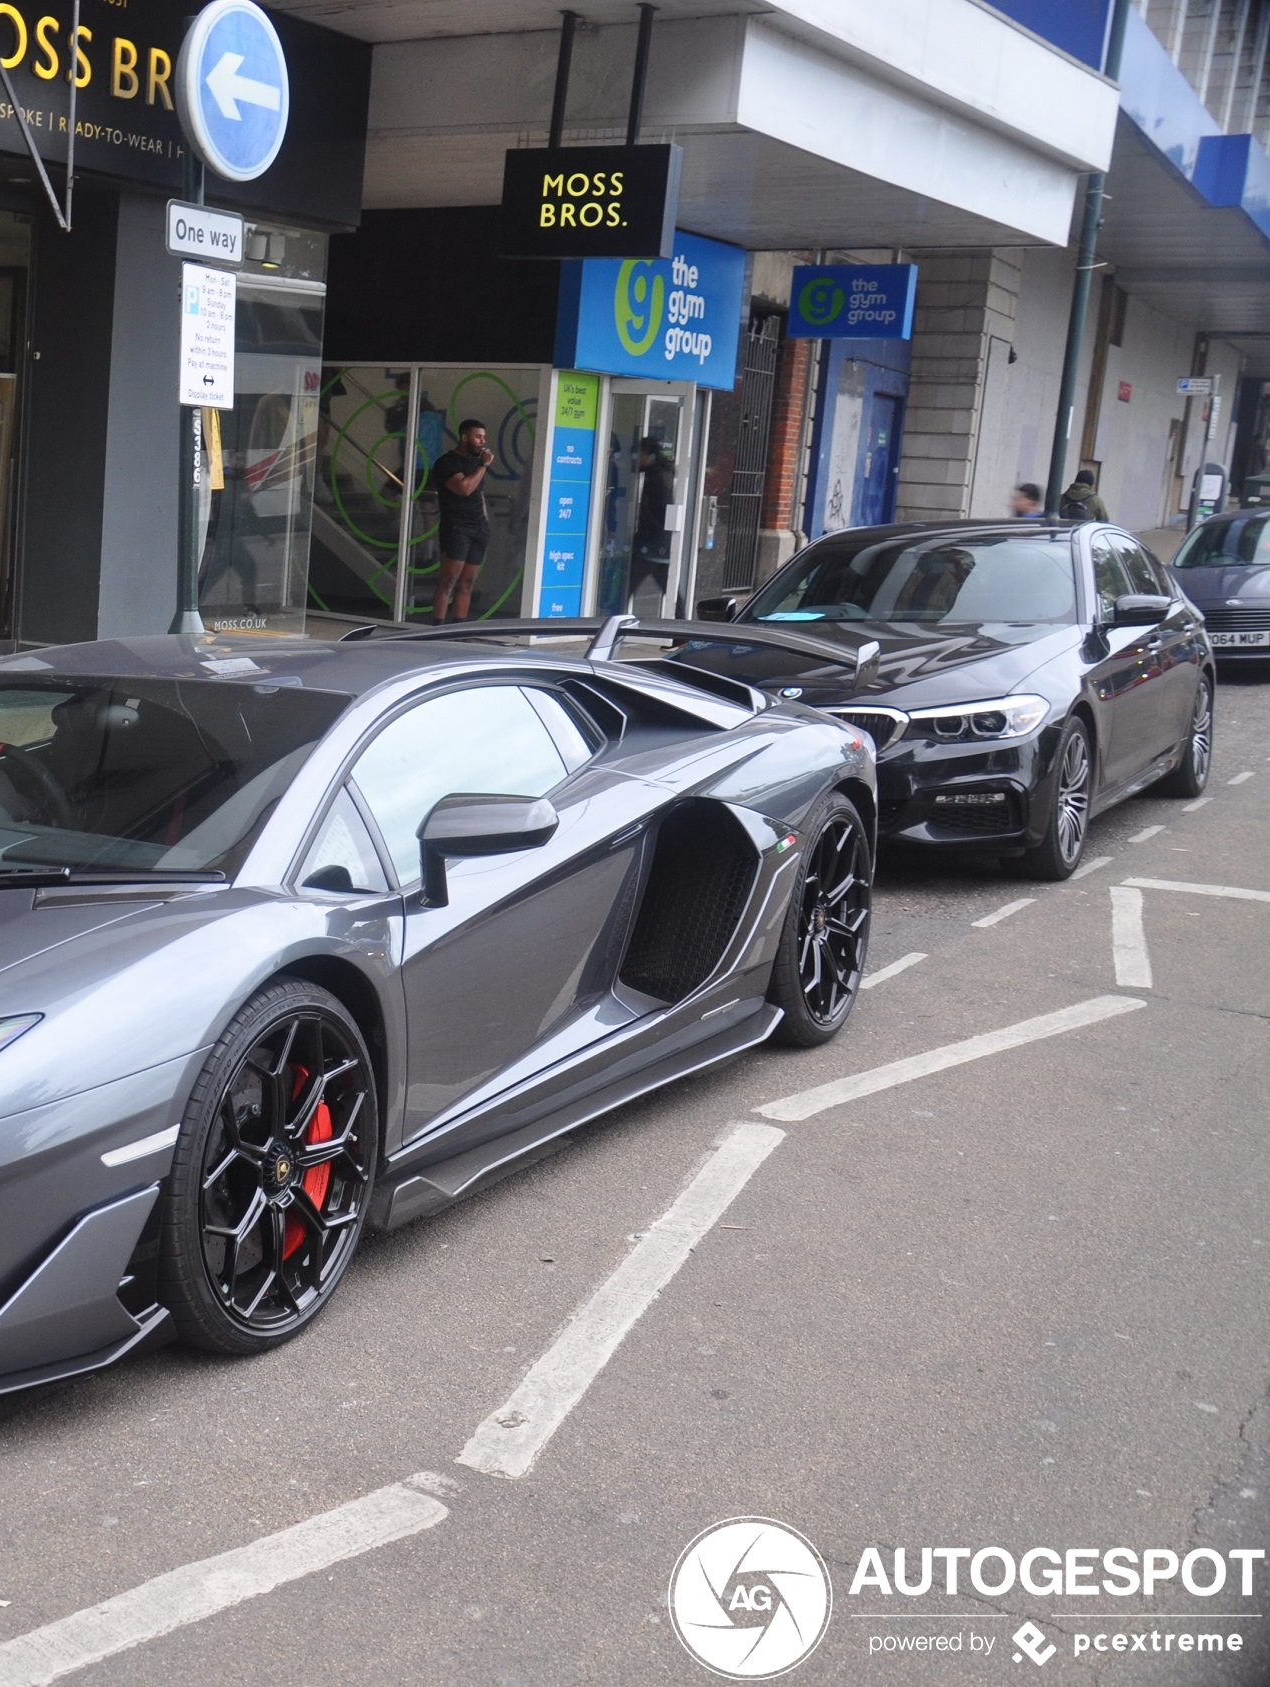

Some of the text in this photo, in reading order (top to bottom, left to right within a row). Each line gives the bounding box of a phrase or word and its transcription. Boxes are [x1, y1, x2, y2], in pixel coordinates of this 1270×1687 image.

[110, 36, 174, 111] BR
[542, 172, 624, 197] MOSS
[539, 202, 628, 228] BROS.
[175, 218, 237, 254] One way
[671, 254, 699, 289] the
[205, 273, 231, 287] Mon Sat
[851, 278, 878, 292] the
[207, 288, 216, 296] am
[223, 291, 233, 299] pm
[207, 297, 227, 312] Sunday
[668, 289, 705, 326] gym
[849, 293, 887, 309] gym
[208, 310, 217, 318] am
[224, 313, 233, 321] pm
[847, 309, 897, 325] group
[211, 321, 226, 332] hours
[195, 332, 221, 344] No return
[190, 346, 206, 355] within
[212, 349, 227, 358] hours
[664, 327, 712, 366] group
[187, 357, 197, 368] Pay
[206, 362, 227, 371] machine
[188, 388, 225, 401] Display ticket
[575, 386, 587, 395] best
[567, 397, 582, 406] value
[561, 406, 585, 419] 24/7 gym
[556, 455, 583, 465] contracts
[559, 497, 573, 506] open
[558, 508, 572, 519] 24/7
[549, 550, 575, 563] high spec
[556, 562, 565, 571] kit
[214, 618, 267, 631] MOSS.CO.UK
[1239, 633, 1264, 644] MUP
